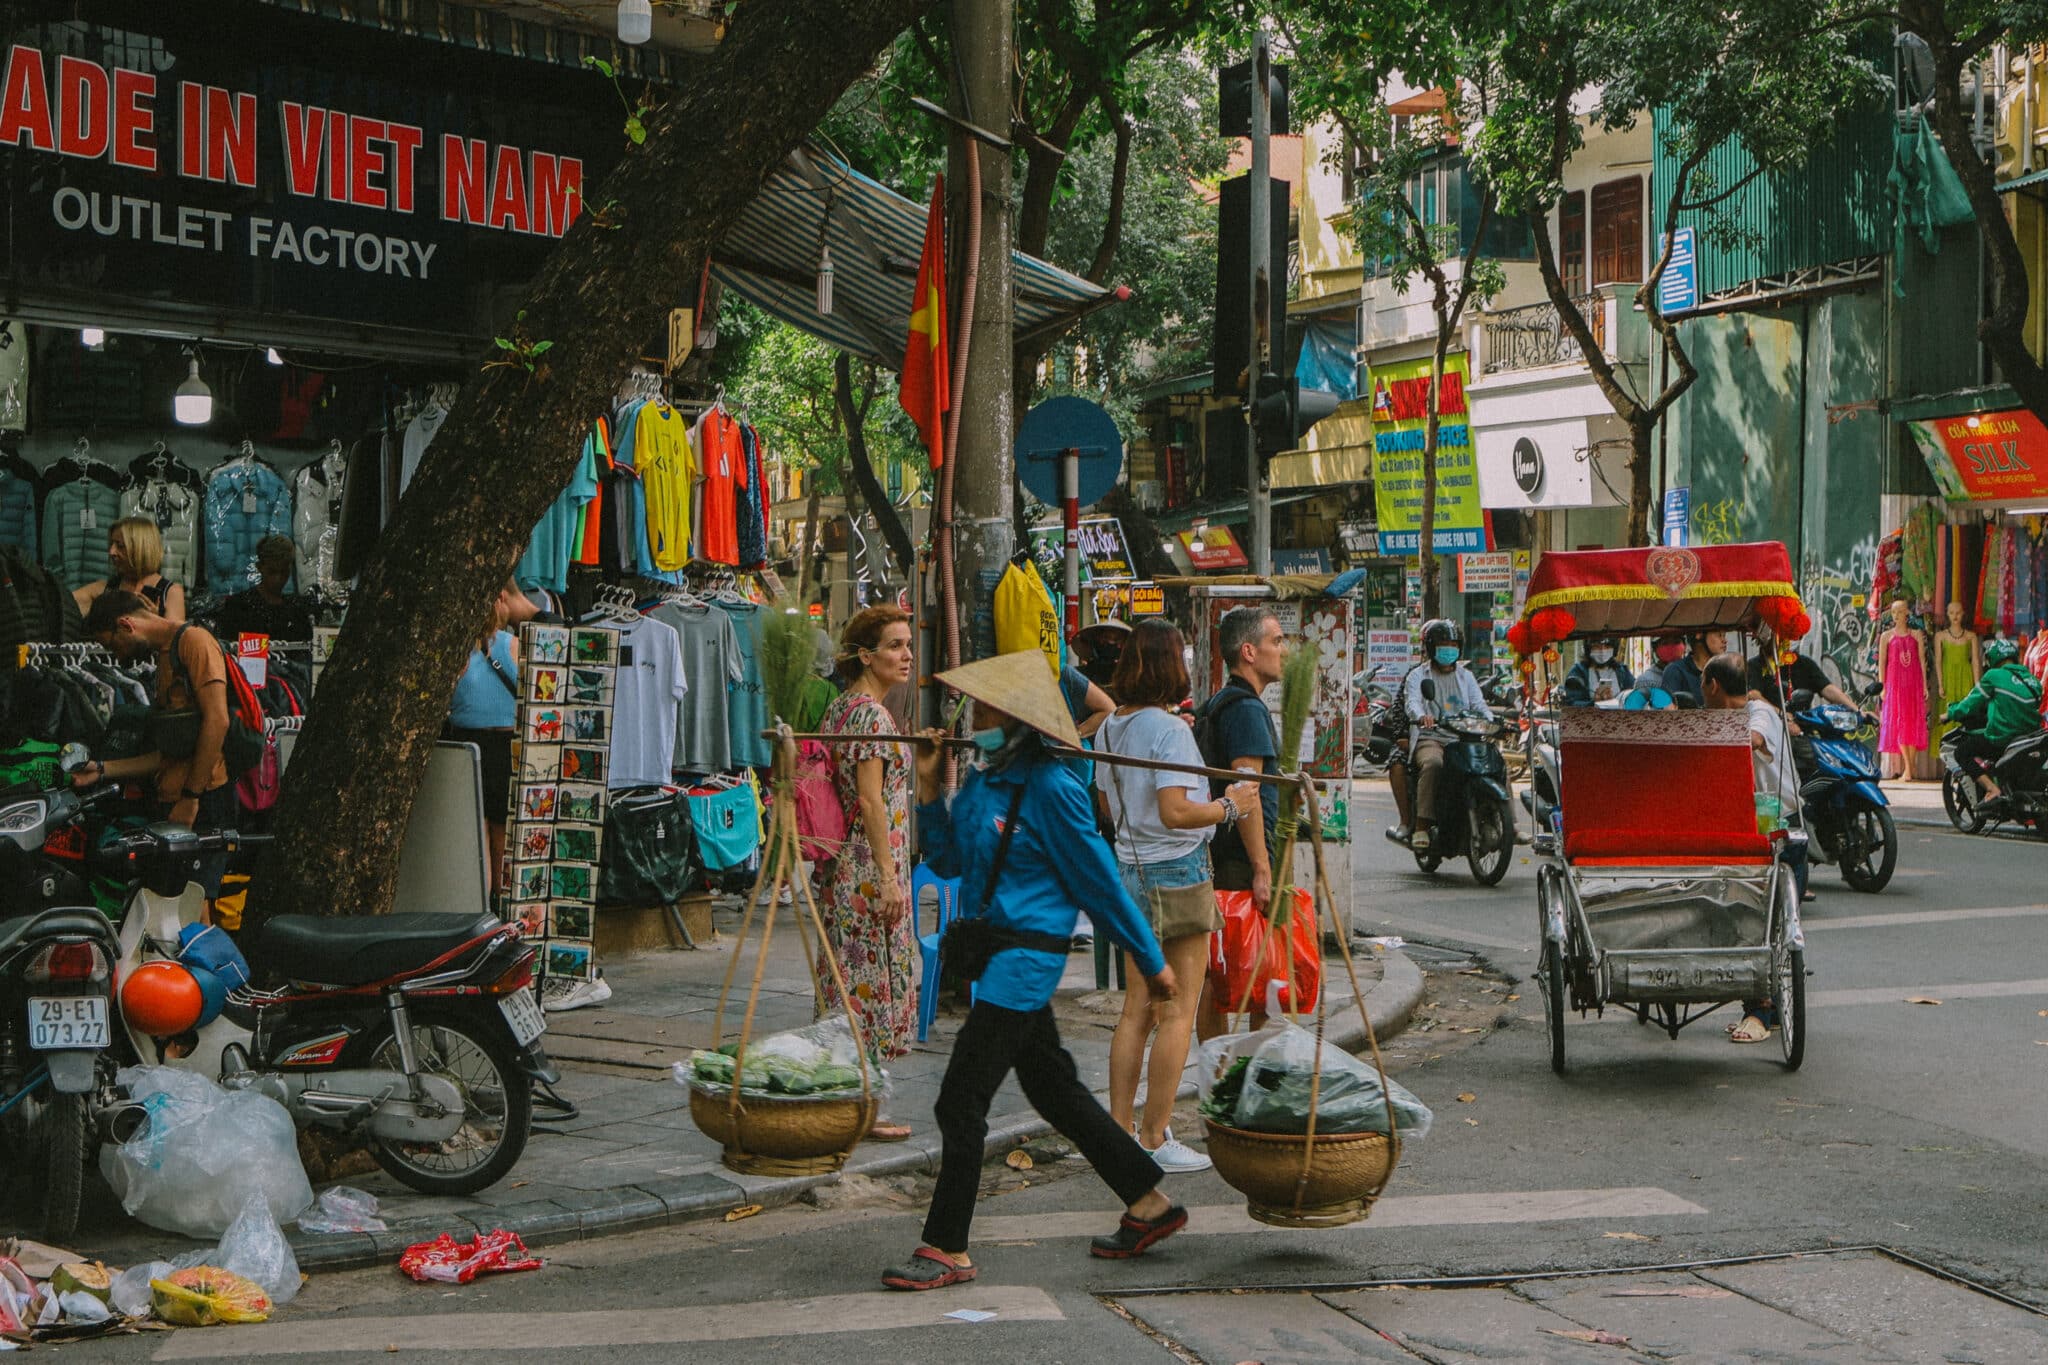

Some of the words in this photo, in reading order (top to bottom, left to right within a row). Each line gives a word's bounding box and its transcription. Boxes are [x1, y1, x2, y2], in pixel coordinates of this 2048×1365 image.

[178, 80, 257, 188] IN
[278, 100, 423, 213] VIET
[440, 133, 583, 238] NAM
[53, 186, 232, 251] OUTLET
[250, 216, 437, 280] FACTORY
[1376, 430, 1425, 452] BOOKING
[1963, 440, 2031, 474] SILK
[1386, 535, 1395, 549] WE
[1396, 534, 1406, 548] ARE
[1407, 534, 1417, 548] THE
[1453, 532, 1463, 547] FOR
[1464, 531, 1478, 547] YOU
[1484, 581, 1510, 589] EXCHANGE
[242, 638, 260, 653] SALE
[41, 1000, 96, 1022] 29-E1
[36, 1022, 104, 1045] 073.27
[285, 1050, 322, 1062] Dream
